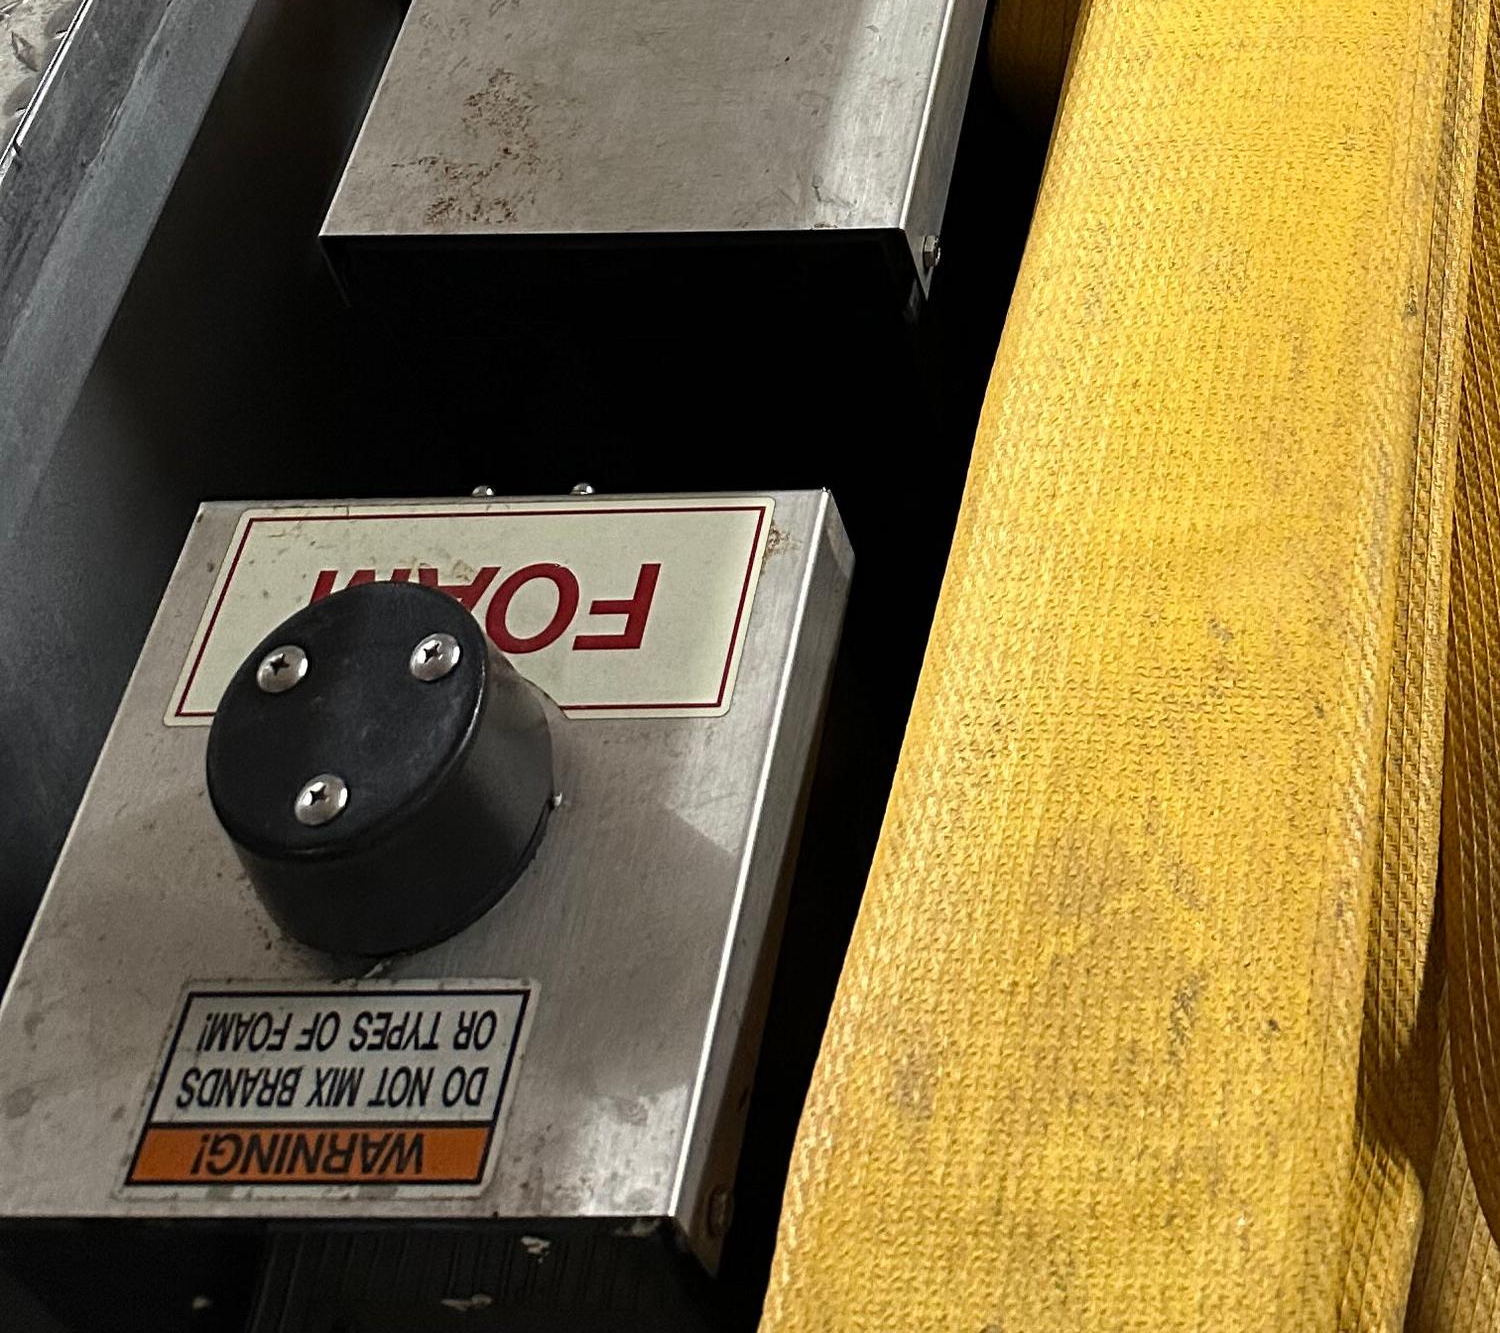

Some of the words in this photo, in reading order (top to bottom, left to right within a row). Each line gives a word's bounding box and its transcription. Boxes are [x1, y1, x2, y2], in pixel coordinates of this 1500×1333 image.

[309, 562, 662, 654] FO
[199, 1011, 293, 1053] FOAM!
[295, 1010, 340, 1052] OF
[349, 1010, 442, 1052] TYPES
[453, 1009, 497, 1051] OR
[175, 1066, 302, 1108] BRANDS
[305, 1066, 364, 1108] MIX
[367, 1066, 433, 1107] NOT
[442, 1066, 489, 1107] DO
[190, 1132, 424, 1175] WARNING!
